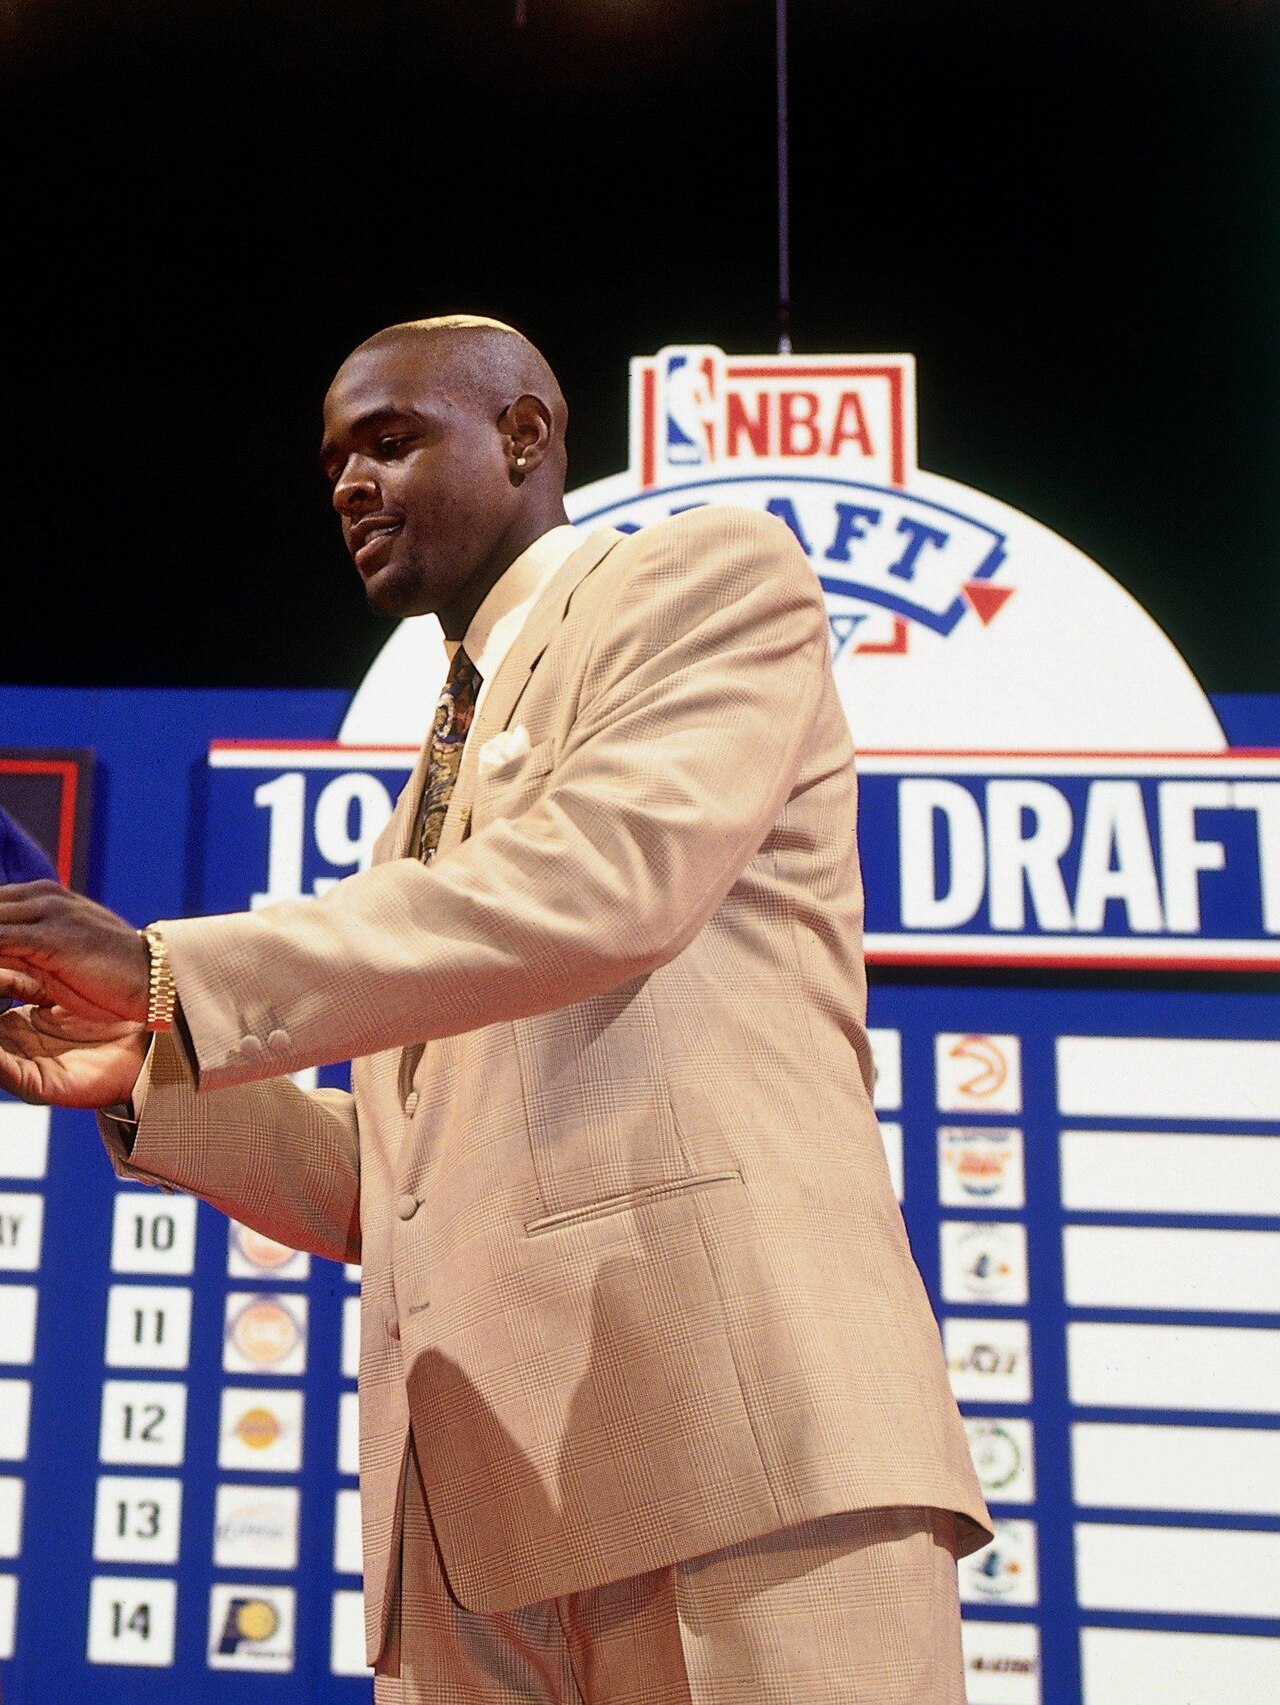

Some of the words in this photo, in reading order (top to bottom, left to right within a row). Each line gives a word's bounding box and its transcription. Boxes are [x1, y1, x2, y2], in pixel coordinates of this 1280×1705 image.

[726, 391, 875, 458] NBA
[251, 772, 395, 912] 19
[898, 778, 1280, 934] DRAFT
[135, 1215, 175, 1251] 10
[135, 1309, 164, 1344] 11
[124, 1404, 166, 1442] 12
[118, 1500, 160, 1538] 13
[113, 1602, 150, 1640] 14
